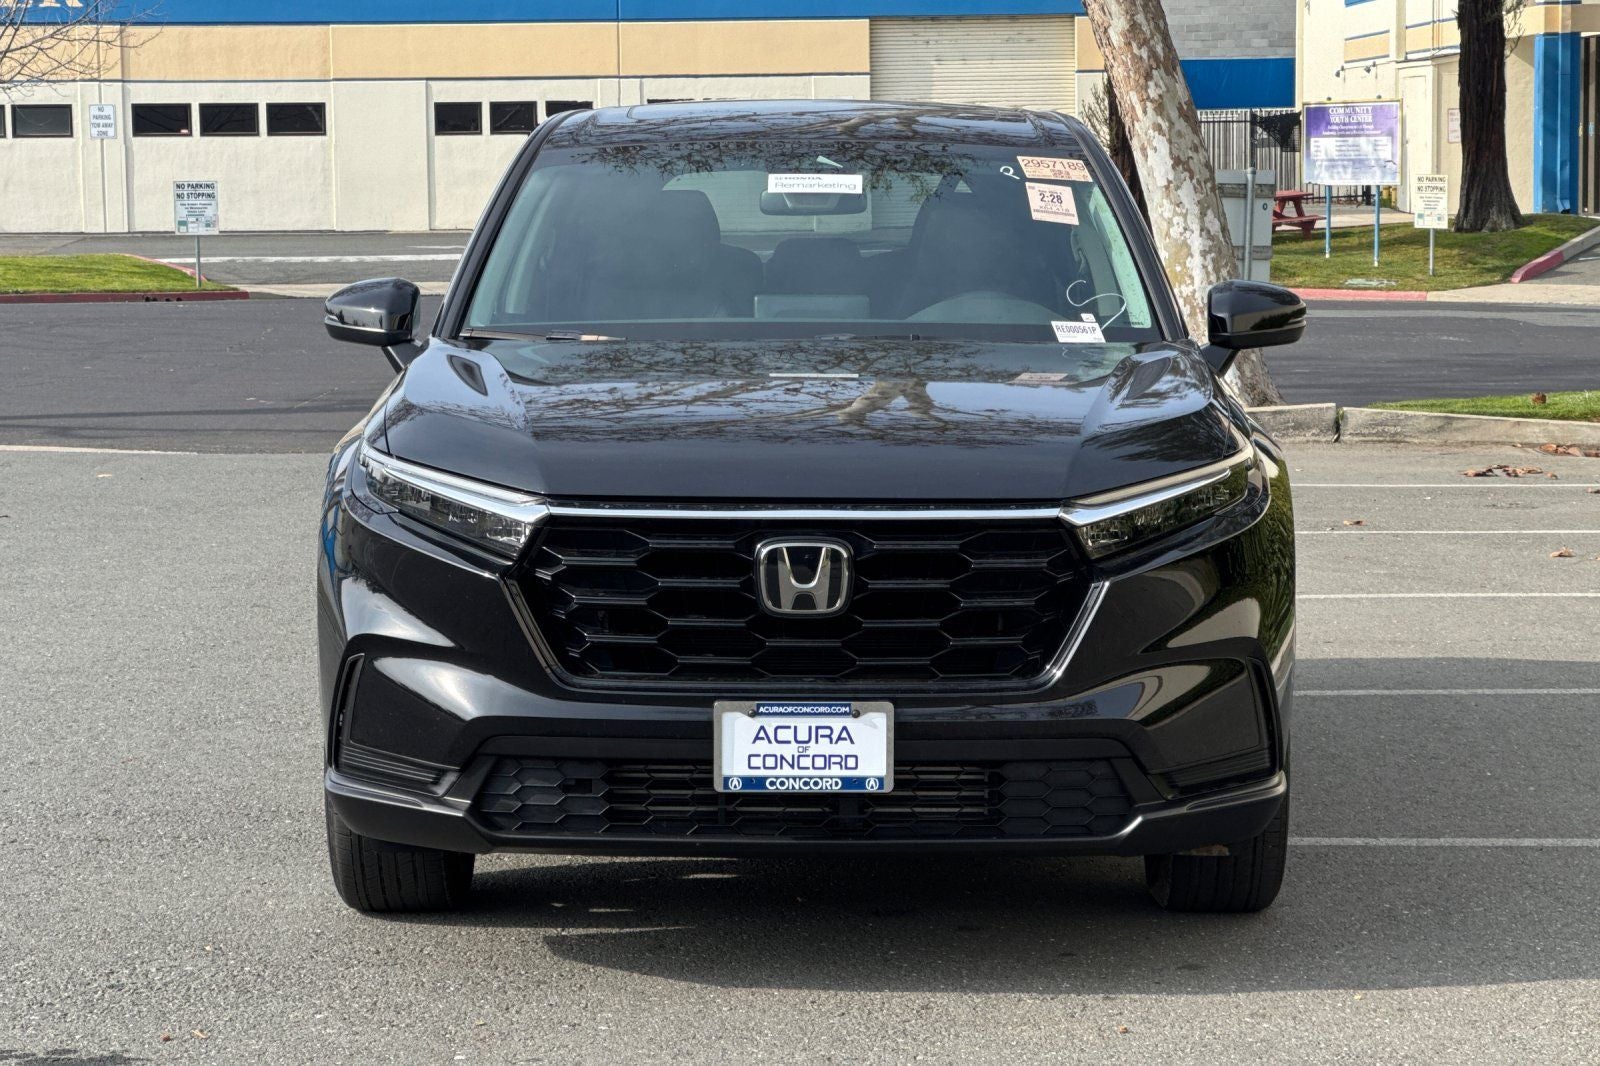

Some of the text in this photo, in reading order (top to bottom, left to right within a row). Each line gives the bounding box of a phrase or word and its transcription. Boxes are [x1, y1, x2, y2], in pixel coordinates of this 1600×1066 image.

[1329, 106, 1373, 115] COMMUNITY
[1022, 158, 1085, 171] 2957189
[186, 182, 215, 190] PARKING
[774, 181, 857, 191] Remarketing
[1425, 185, 1446, 193] STOPPING
[186, 192, 216, 200] STOPPING
[758, 705, 850, 714] ACURAOFCONCORD.COM
[751, 725, 855, 745] ACURA
[797, 745, 810, 754] OF
[747, 754, 859, 771] CONCORD
[765, 777, 842, 790] CONCORD
